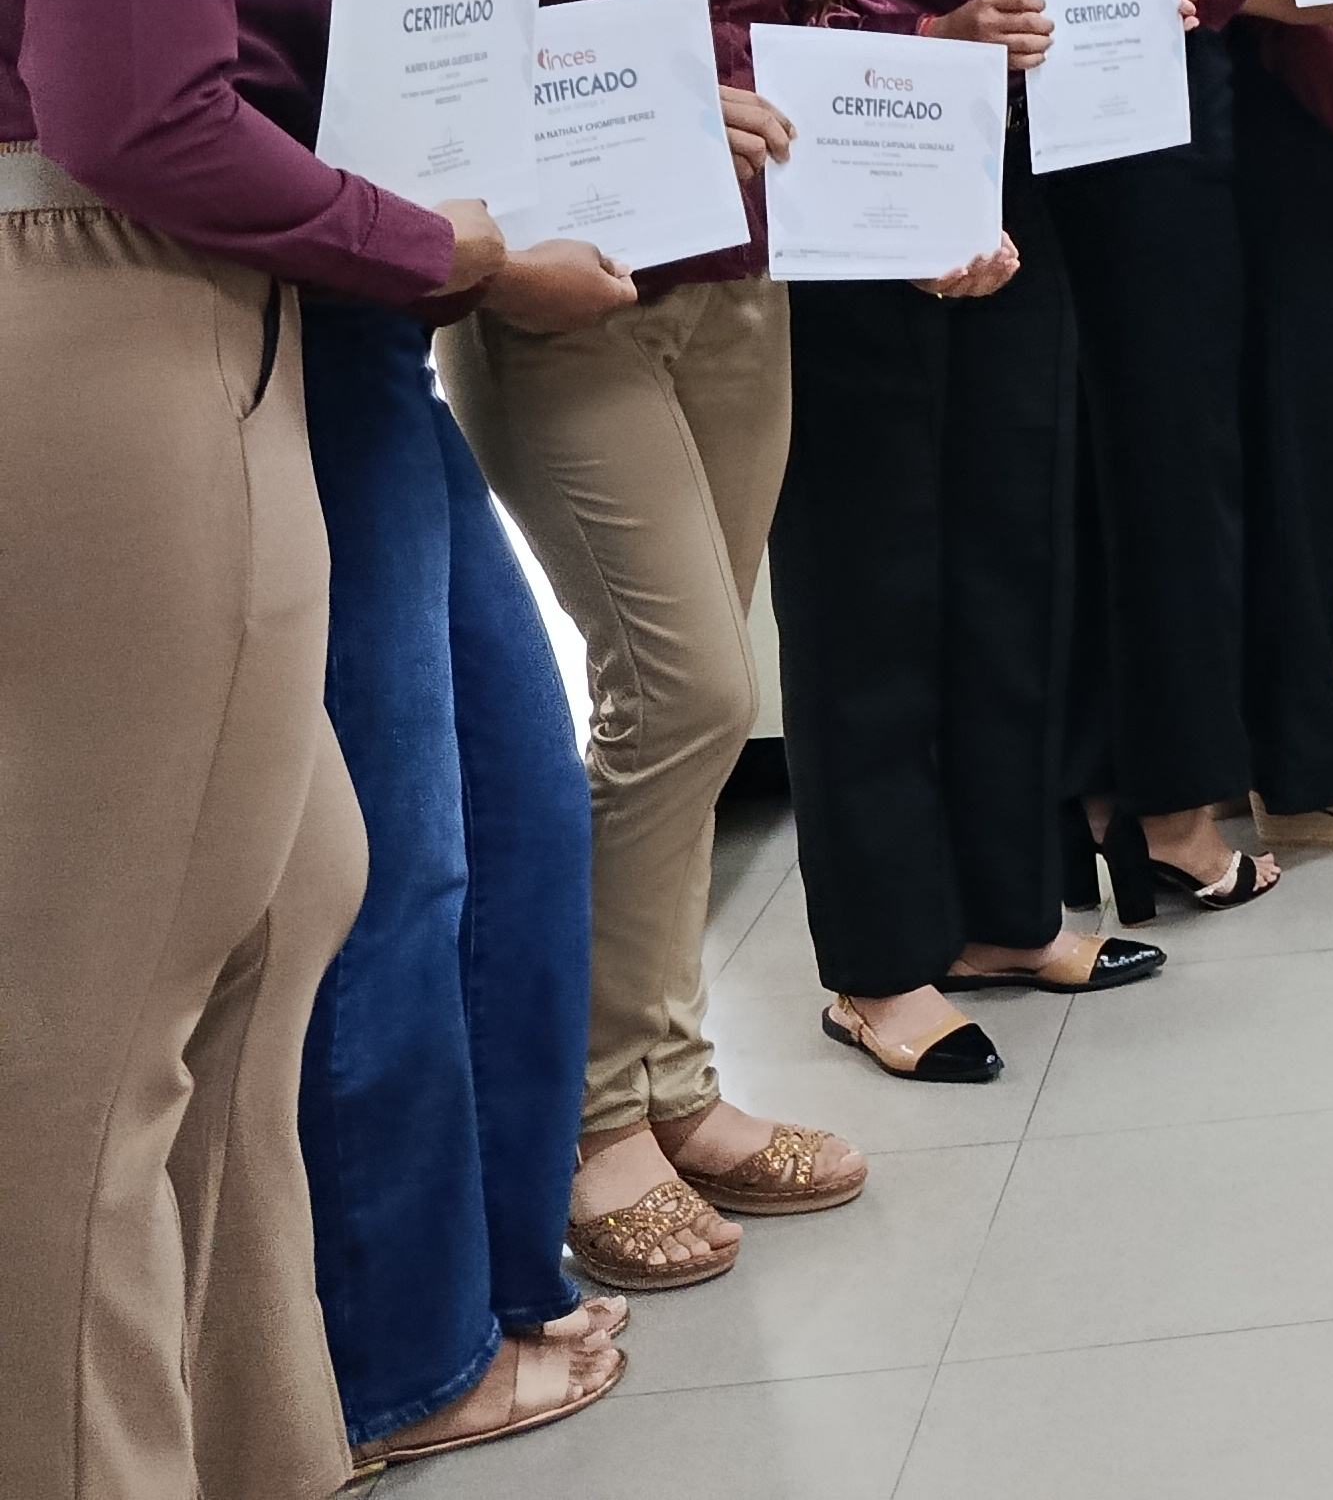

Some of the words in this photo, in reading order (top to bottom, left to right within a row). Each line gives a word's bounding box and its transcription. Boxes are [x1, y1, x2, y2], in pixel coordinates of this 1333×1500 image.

[1065, 1, 1141, 25] CERTIFICADO
[537, 48, 597, 71] inces
[534, 68, 638, 106] RTIFICADO
[864, 68, 914, 92] inces
[832, 95, 943, 121] CERTIFICADO
